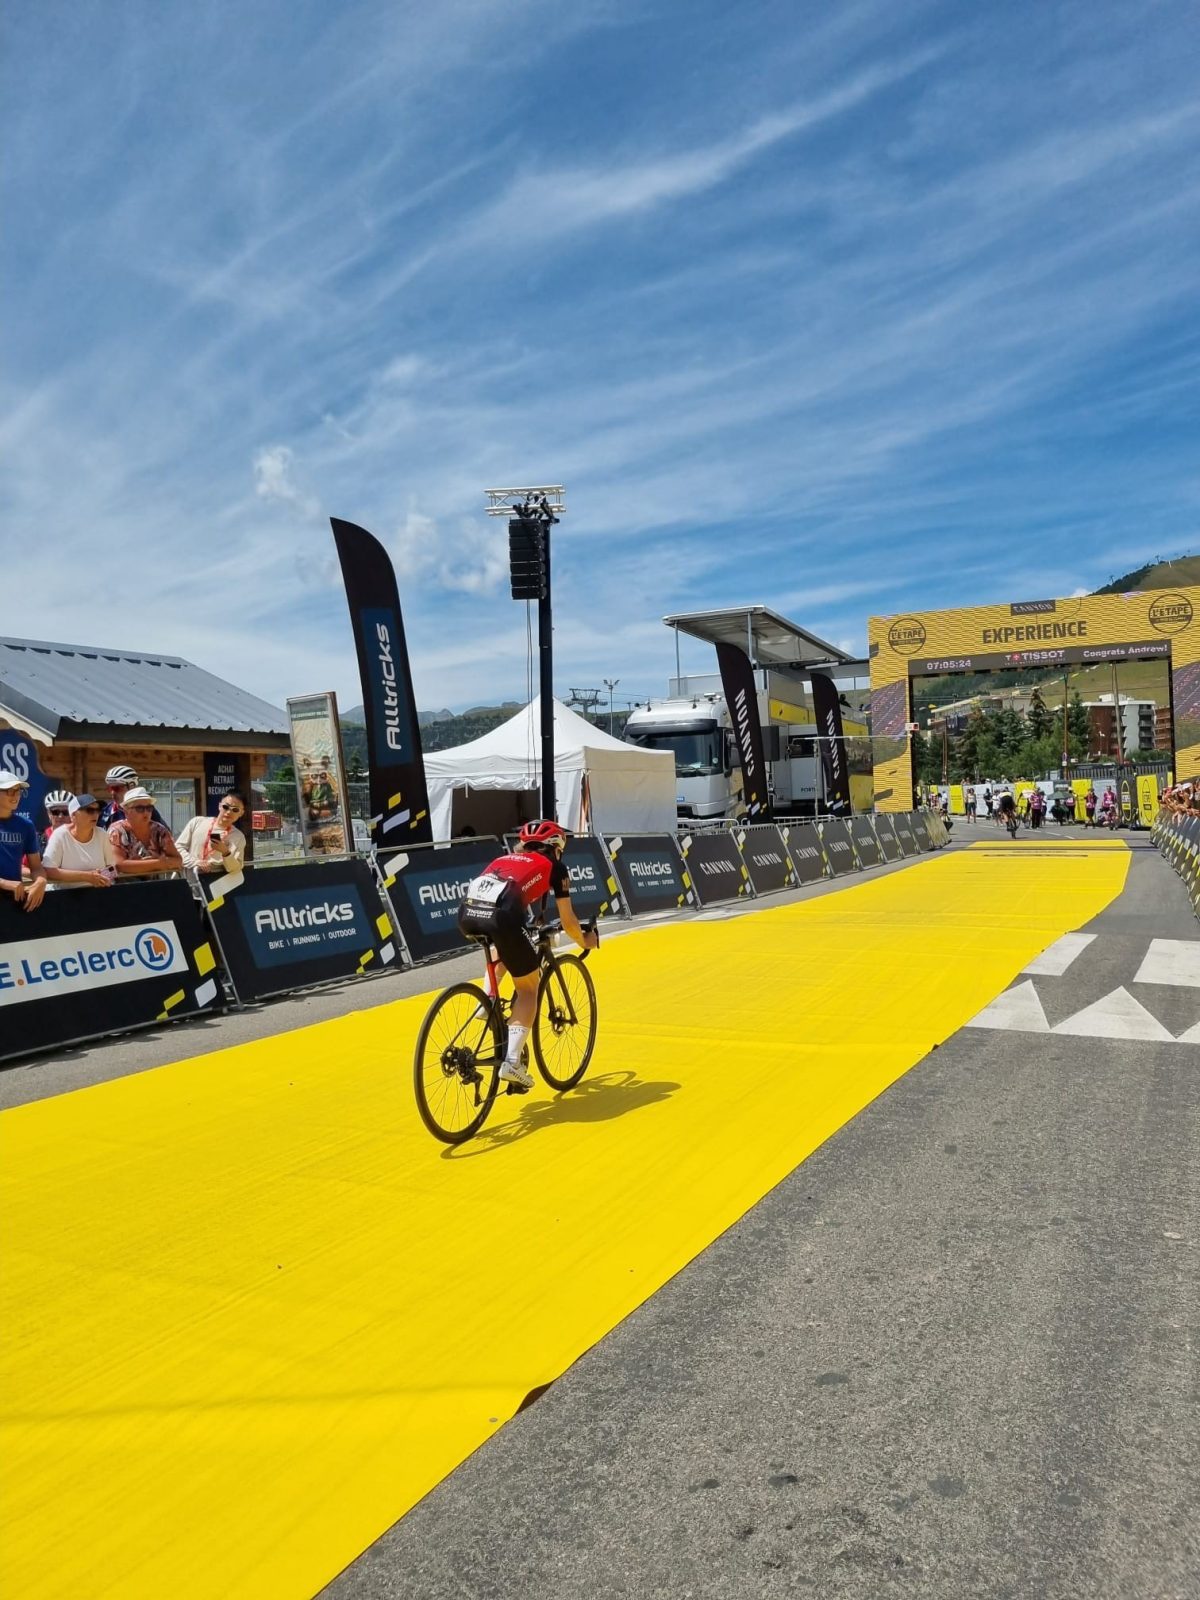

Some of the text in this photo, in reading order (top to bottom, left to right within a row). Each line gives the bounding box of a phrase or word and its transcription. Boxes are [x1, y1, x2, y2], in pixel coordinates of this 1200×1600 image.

[982, 620, 1087, 644] EXPERIENCE
[1083, 644, 1168, 658] Congrats Andrew!
[376, 623, 402, 750] Alltricks
[735, 688, 755, 777] CANYON
[217, 765, 235, 774] ACHAT
[700, 860, 736, 875] CANYON
[752, 852, 782, 867] CANYON
[629, 862, 672, 877] Alltricks
[254, 901, 355, 934] Alltricks
[268, 928, 357, 950] BIKE RUNNING OUTDOOR
